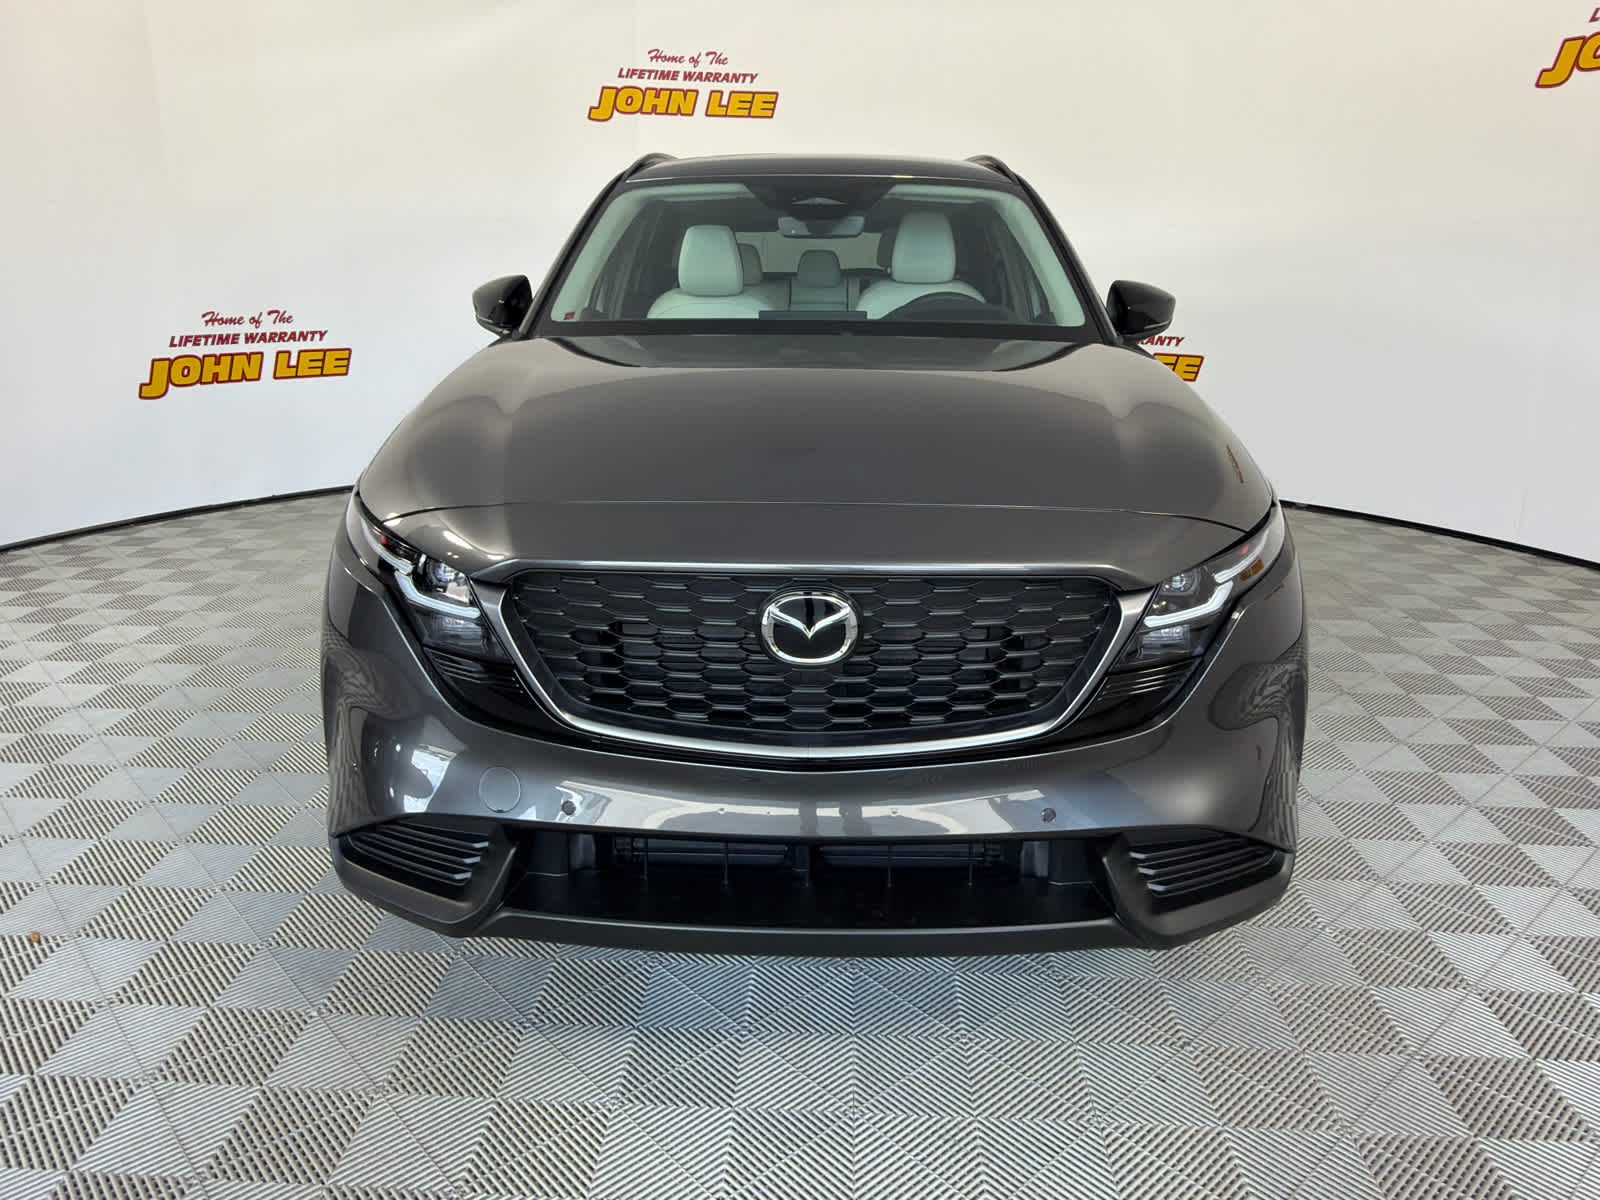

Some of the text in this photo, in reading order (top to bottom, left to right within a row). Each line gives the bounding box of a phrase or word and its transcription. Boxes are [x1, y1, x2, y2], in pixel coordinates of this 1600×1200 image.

[648, 49, 728, 68] Home of The
[618, 68, 758, 83] LIFETIME WARRANTY
[588, 86, 779, 121] JOHN LEE
[201, 310, 294, 329] Home of The
[169, 330, 328, 348] LIFETIME WARRANTY
[138, 348, 352, 399] JOHN LEE
